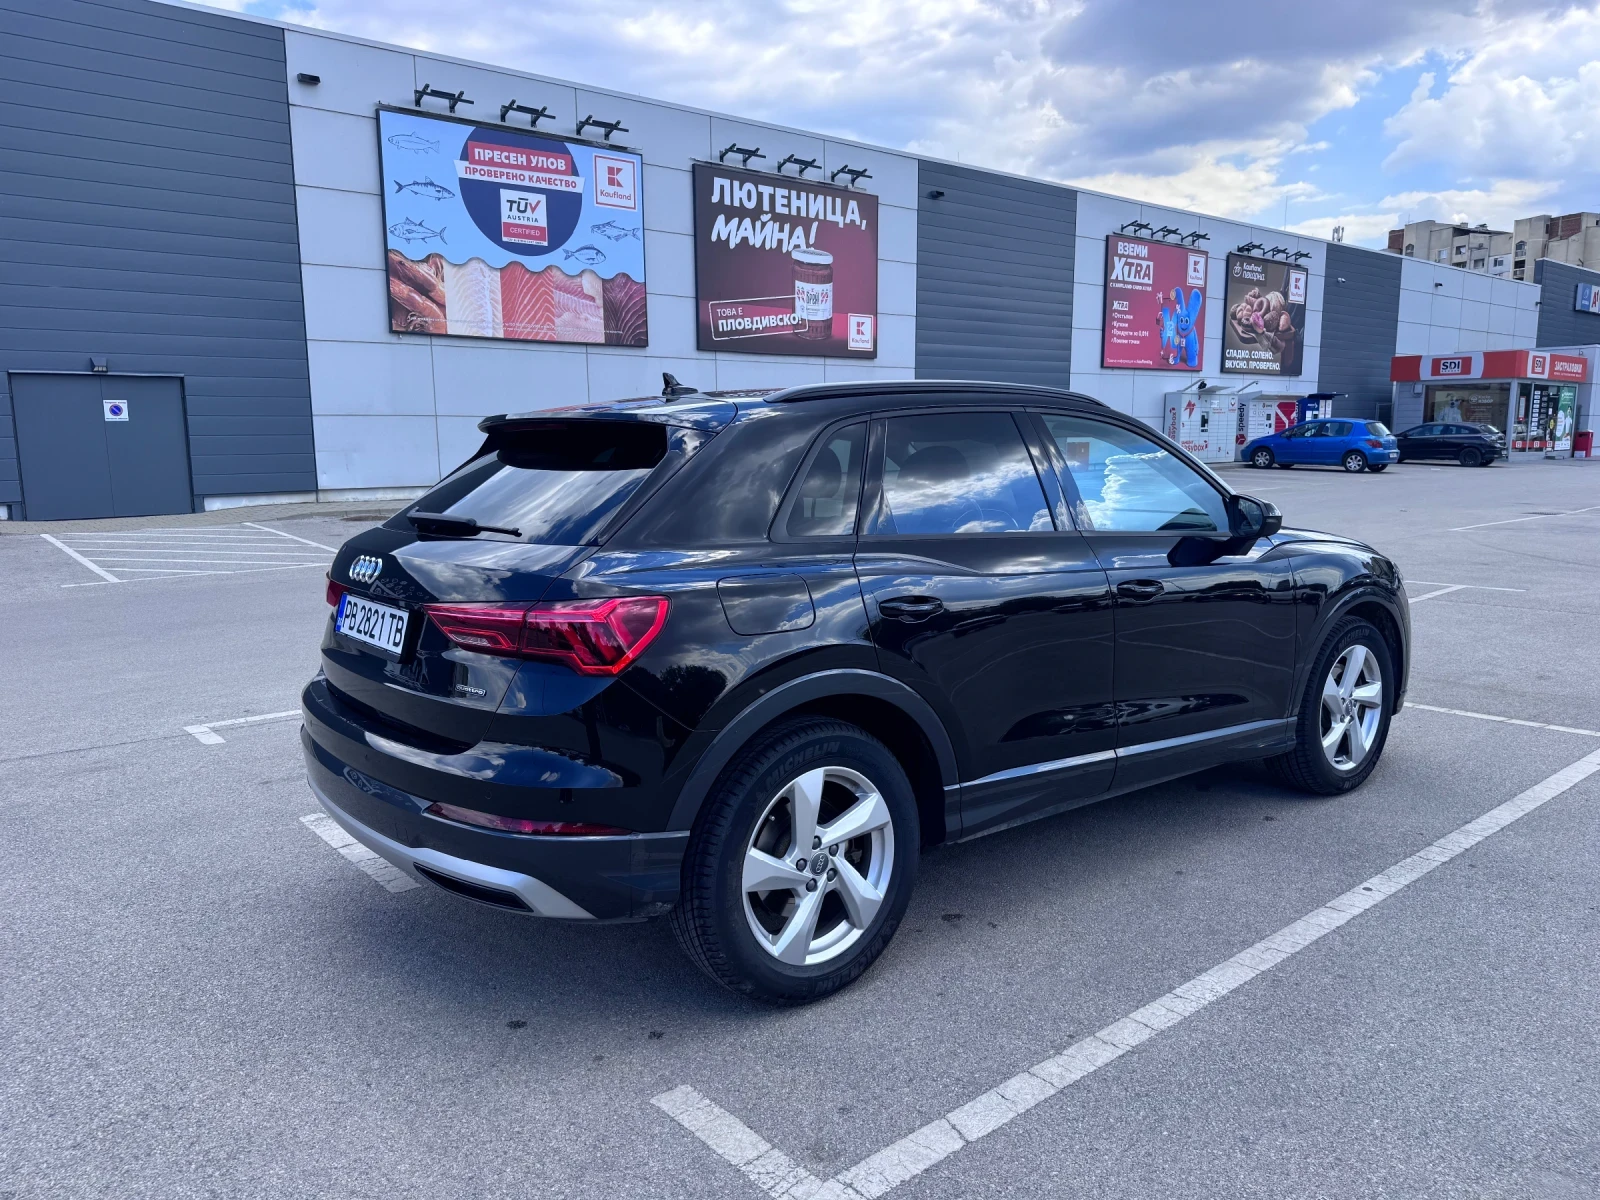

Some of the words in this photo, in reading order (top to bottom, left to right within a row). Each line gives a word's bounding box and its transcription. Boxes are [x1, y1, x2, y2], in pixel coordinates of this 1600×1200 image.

[474, 148, 527, 166] ПРЕСЕН
[530, 155, 566, 170] УЛОВ
[464, 166, 526, 182] ПРОВЕРЕНО
[528, 175, 577, 189] КАЧЕСТВО
[600, 189, 632, 201] Kaufland
[711, 176, 867, 231] ЛЮТЕНИЦА,
[507, 214, 539, 223] AUSTRIA
[510, 227, 540, 237] CERTIFIED
[711, 213, 818, 253] МАЙНА!
[1117, 241, 1148, 258] ВЗЕМИ
[1110, 256, 1152, 283] XTRA
[1243, 262, 1263, 272] Kaufland
[716, 308, 737, 317] ТОВА
[718, 312, 803, 332] ПЛОВДИВСКО!
[1225, 349, 1250, 359] СЛАДКО.
[1251, 350, 1274, 360] СОЛЕНО.
[1225, 360, 1248, 369] ВКУСНО.
[1249, 361, 1281, 371] ПРОВЕРЕНО.
[1441, 360, 1461, 370] SDI
[1535, 359, 1543, 369] SDI
[1554, 361, 1583, 373] ЗАСТРАХОВКИ
[1237, 402, 1247, 432] speedy
[356, 605, 386, 642] 2821
[1338, 627, 1370, 651] MICHELIN
[766, 741, 841, 789] MICHELIN
